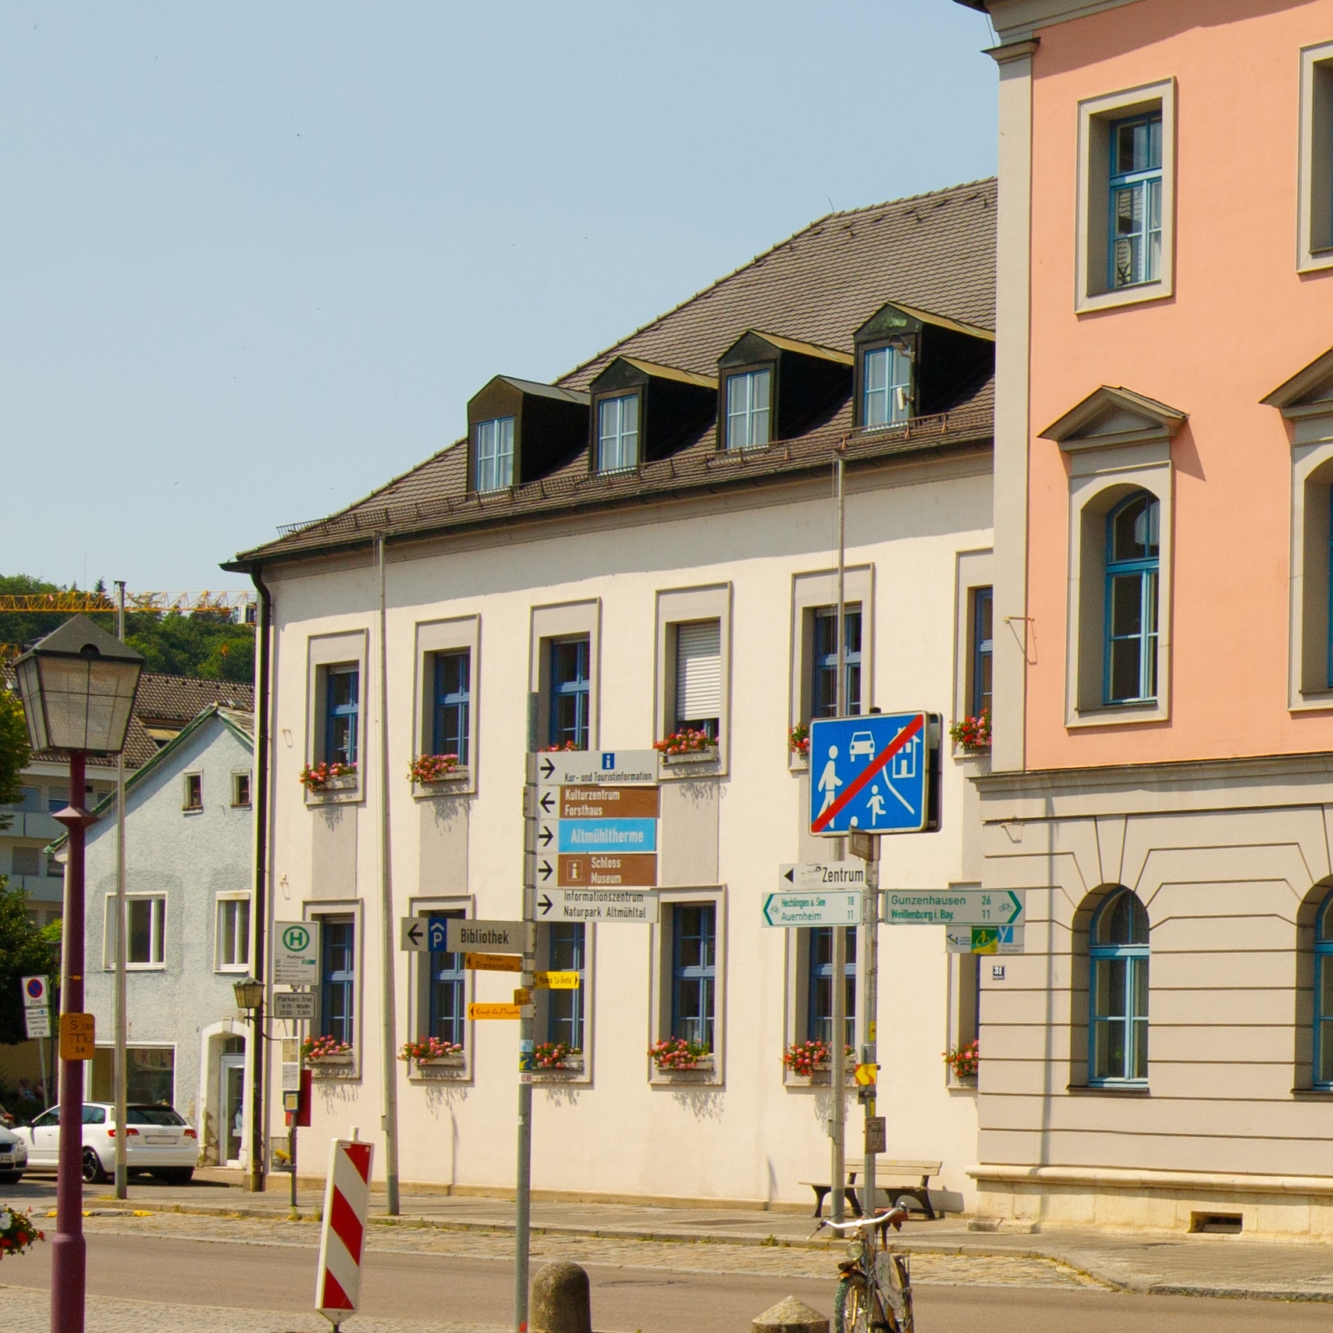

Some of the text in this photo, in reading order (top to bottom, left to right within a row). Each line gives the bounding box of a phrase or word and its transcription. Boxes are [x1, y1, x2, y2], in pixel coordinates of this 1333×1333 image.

[564, 772, 653, 782] Kur- und Touristinformation
[564, 789, 620, 801] Kulturzentrum
[564, 804, 603, 816] Forsthaus
[571, 828, 644, 843] Altmühltherme
[591, 857, 622, 869] Schloss
[591, 872, 622, 884] Museum
[822, 867, 864, 883] Zentrum
[564, 890, 644, 903] Informationszentrum
[891, 895, 991, 906] Gunzenhausen 26
[781, 897, 810, 910] Hechlingen
[816, 897, 826, 907] See
[563, 906, 646, 920] Naturpark Altmühltal
[781, 910, 854, 922] Auernheim 11
[891, 909, 934, 921] Weißenburg
[982, 909, 991, 919] 11
[460, 928, 509, 945] Bibliothek
